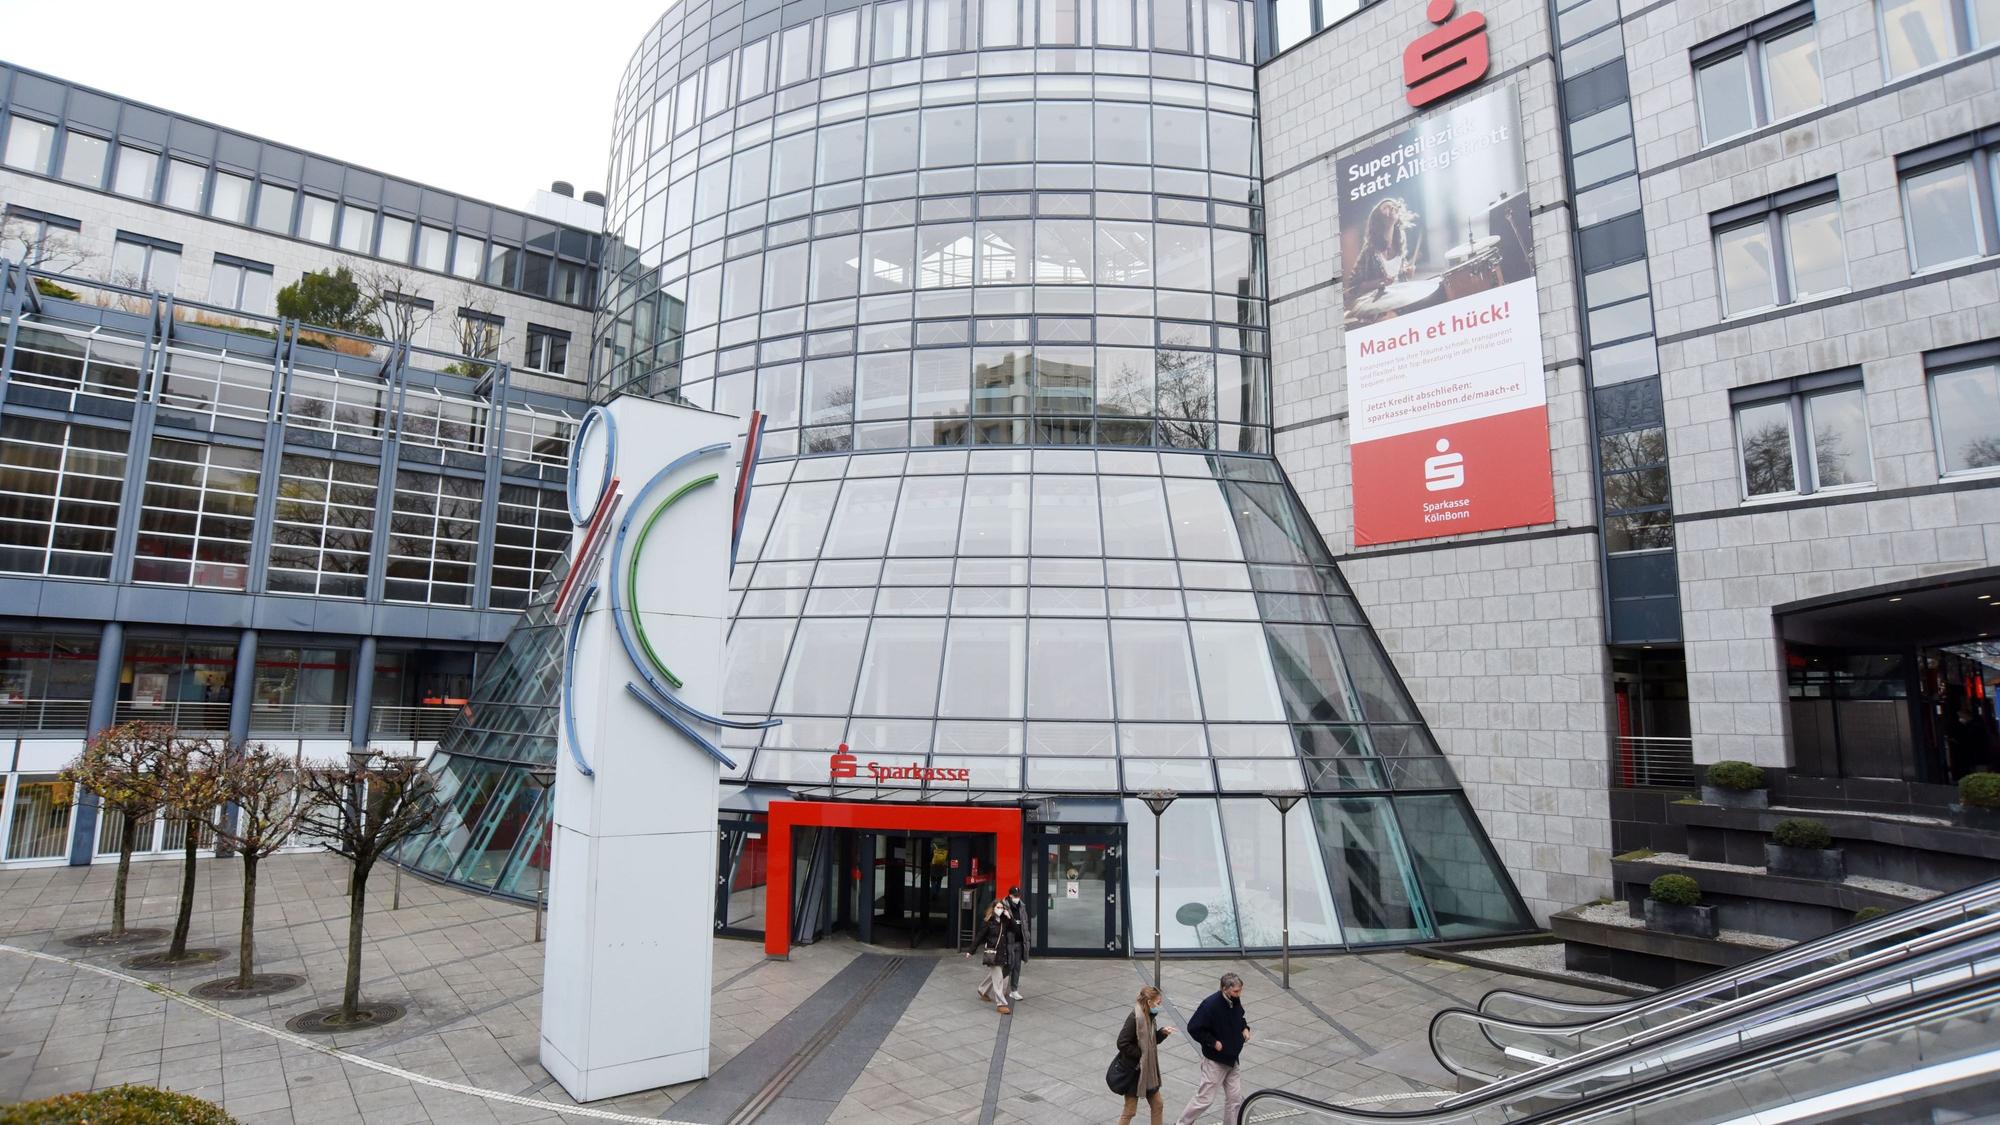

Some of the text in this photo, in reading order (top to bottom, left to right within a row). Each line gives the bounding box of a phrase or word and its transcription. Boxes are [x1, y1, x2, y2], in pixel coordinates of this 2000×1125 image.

[1350, 125, 1509, 201] statt Alltagstrott
[1359, 301, 1511, 358] Maach et hück!
[1367, 382, 1472, 412] Jetzt Kredit abschließen:
[1367, 383, 1520, 424] sparkasse-koelnbonn.de/maach-et
[1423, 498, 1470, 512] Sparkasse
[1424, 511, 1470, 523] KölnBonn
[867, 762, 970, 783] Sparkasse
